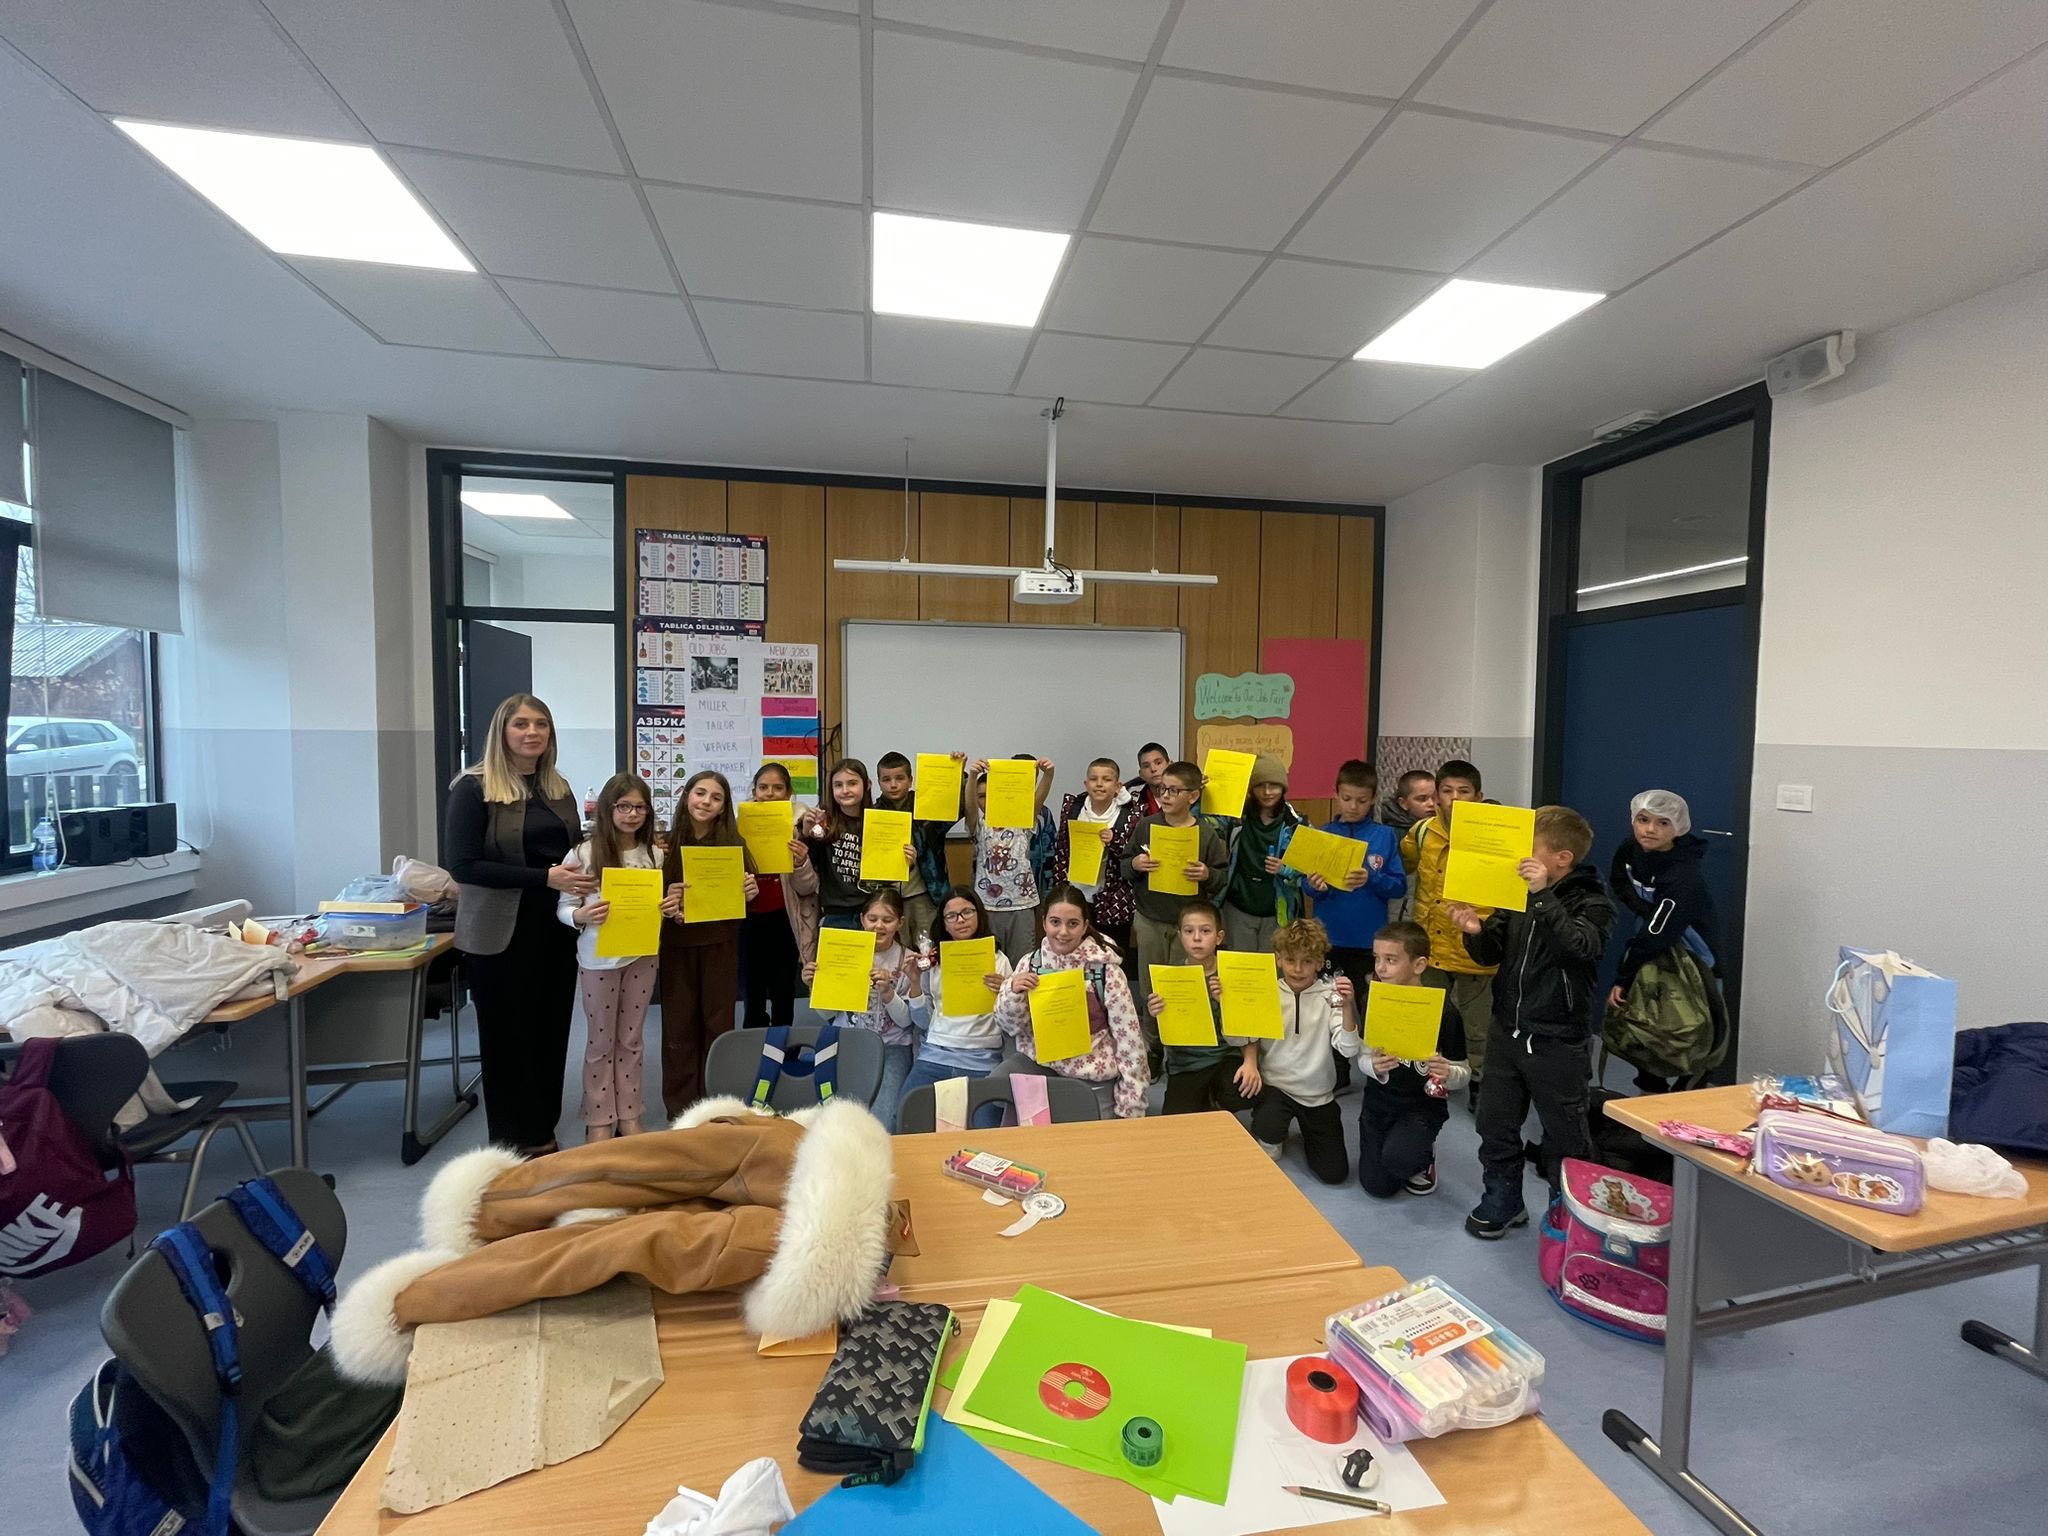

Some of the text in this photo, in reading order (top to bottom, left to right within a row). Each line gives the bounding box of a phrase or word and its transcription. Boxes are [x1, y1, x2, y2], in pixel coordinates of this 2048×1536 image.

[662, 532, 696, 541] TABLICA
[698, 534, 742, 544] MNOŽENJA
[659, 622, 735, 632] TABLICA DELJENJA
[769, 646, 787, 656] NEW
[698, 699, 729, 712] MILLER
[706, 720, 735, 730] TAILOR
[703, 742, 737, 752] WEAVER
[834, 848, 843, 857] TO
